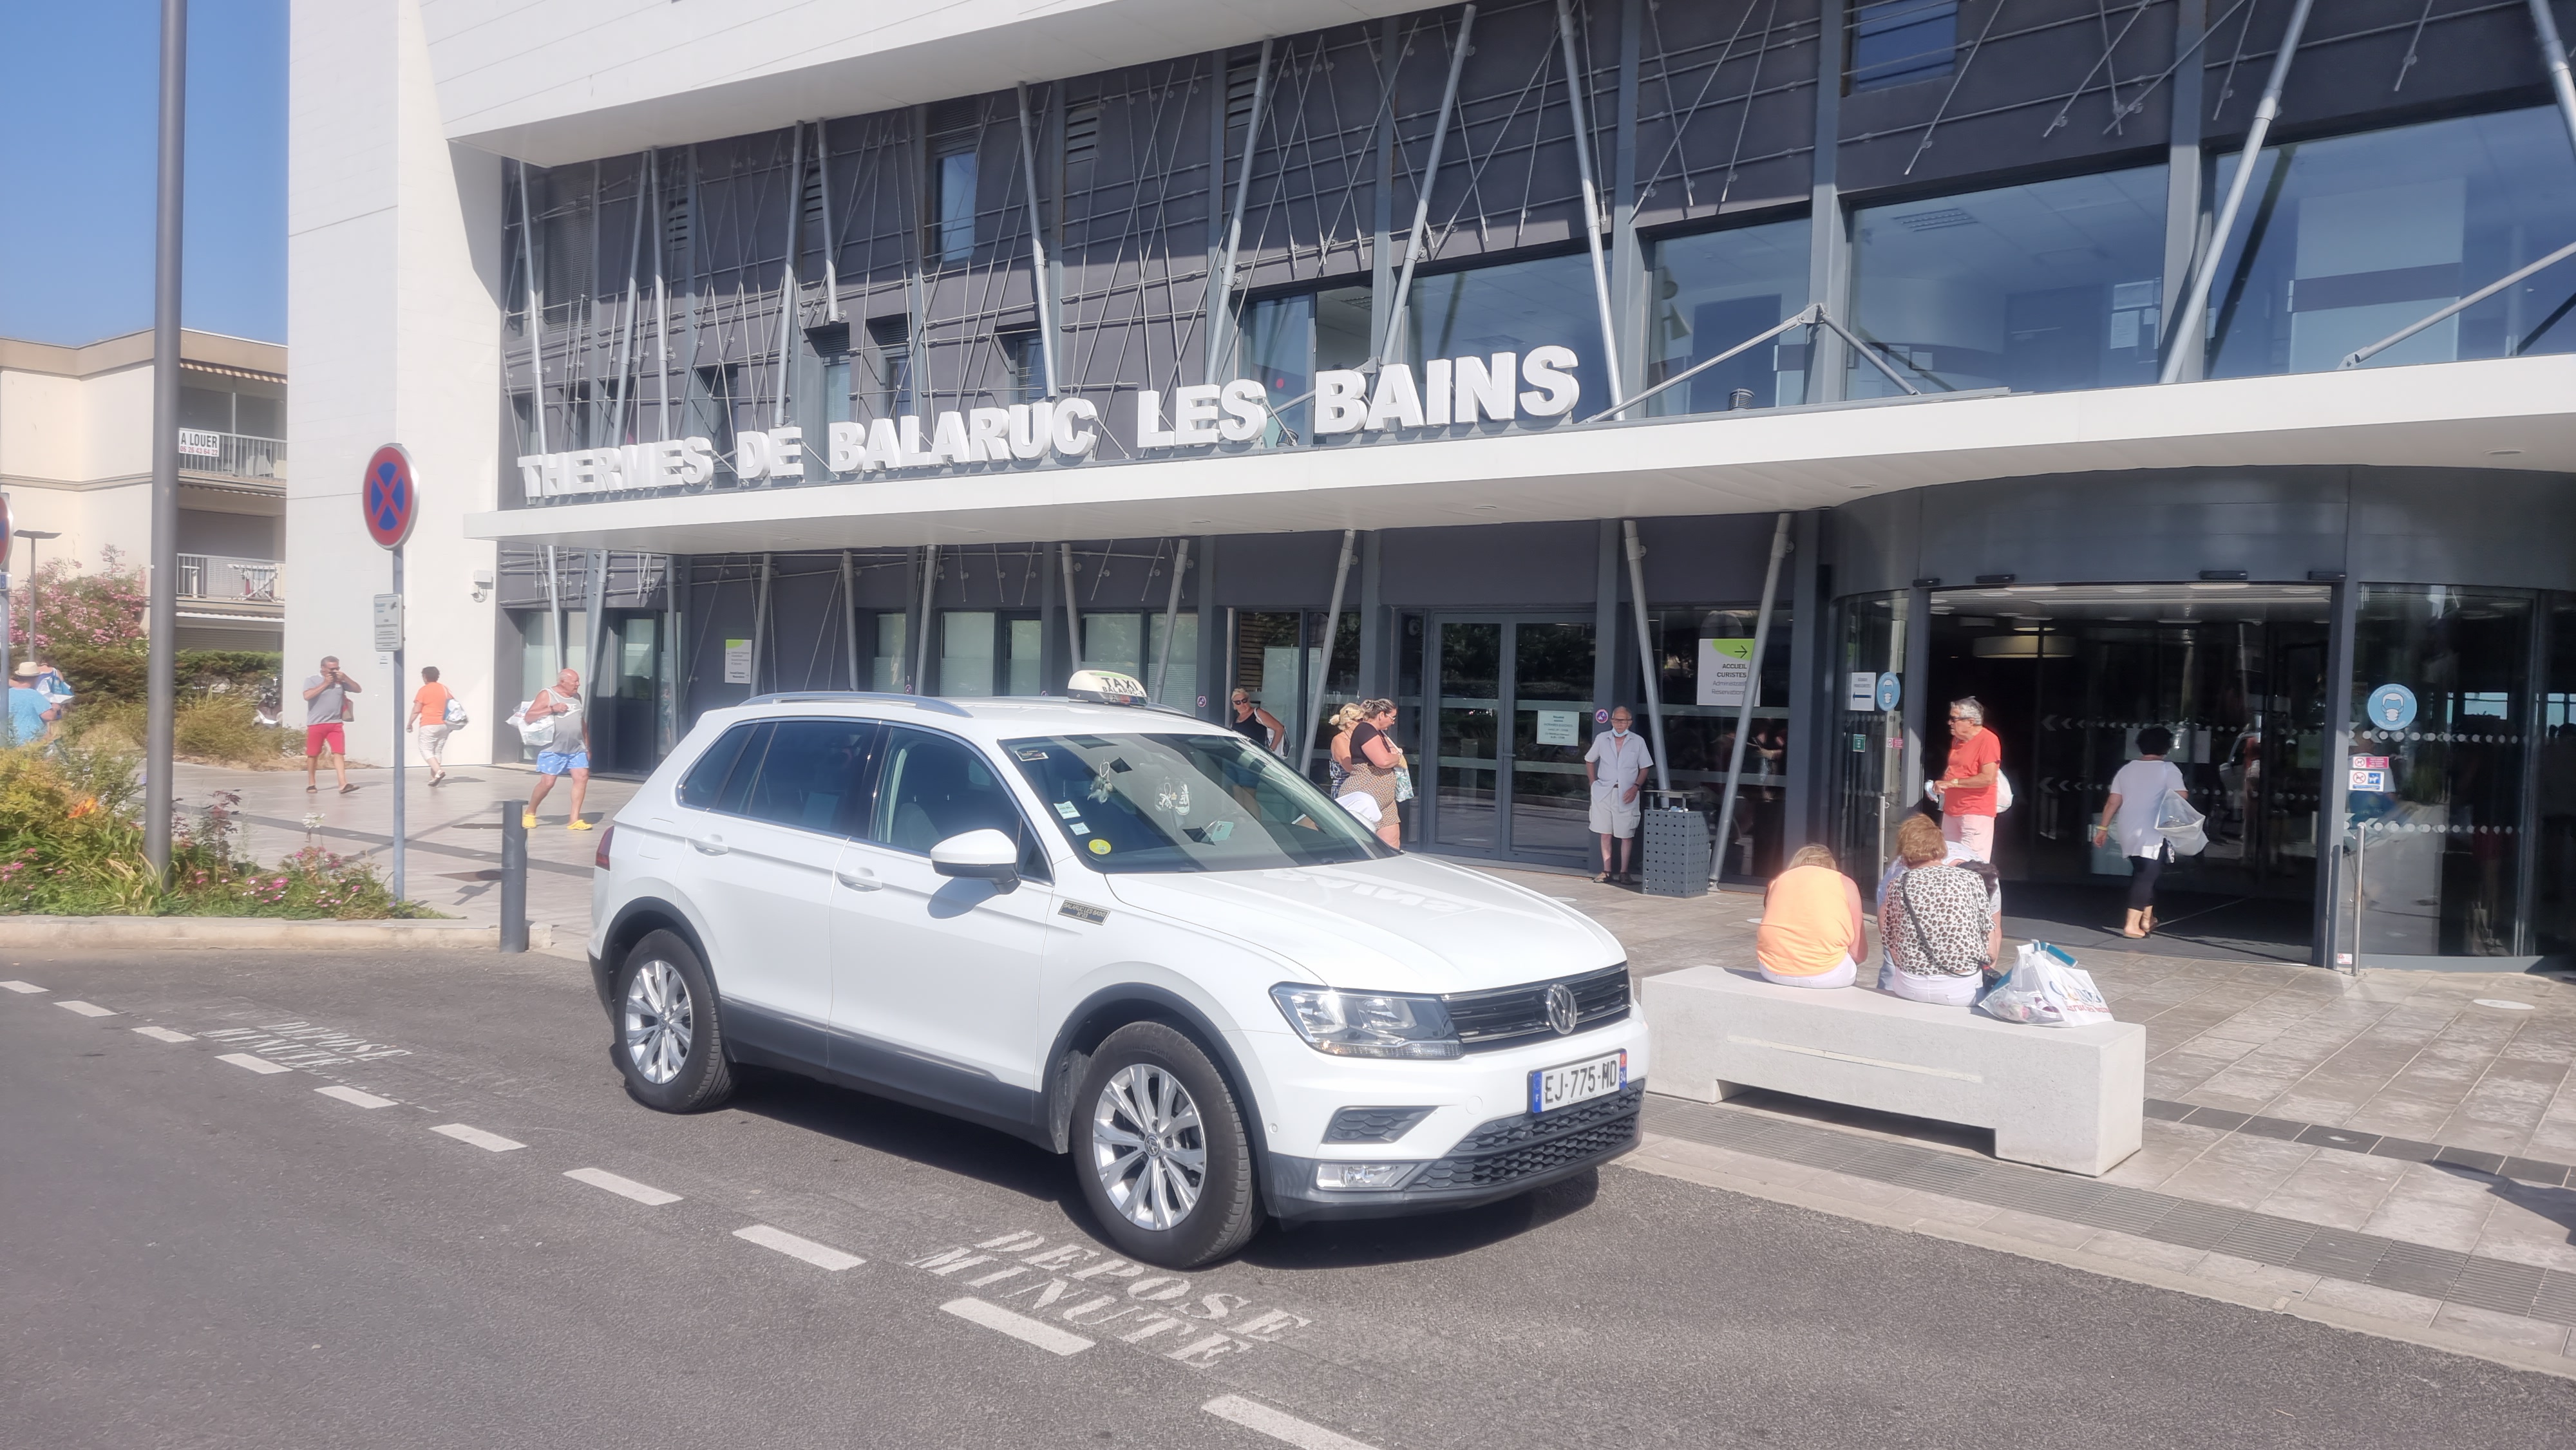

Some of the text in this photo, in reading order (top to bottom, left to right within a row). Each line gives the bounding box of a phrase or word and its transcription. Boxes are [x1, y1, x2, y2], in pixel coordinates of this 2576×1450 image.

[517, 345, 1580, 505] THERMES DE BALARUC LES BAINS
[180, 432, 218, 449] A LOUER
[1101, 677, 1139, 692] TAXI
[1545, 1060, 1617, 1104] EJ-775-MD
[1620, 1069, 1626, 1084] 34
[1535, 1094, 1540, 1103] F
[974, 1229, 1313, 1343] DEPOSE
[904, 1247, 1253, 1370] MINUTE
